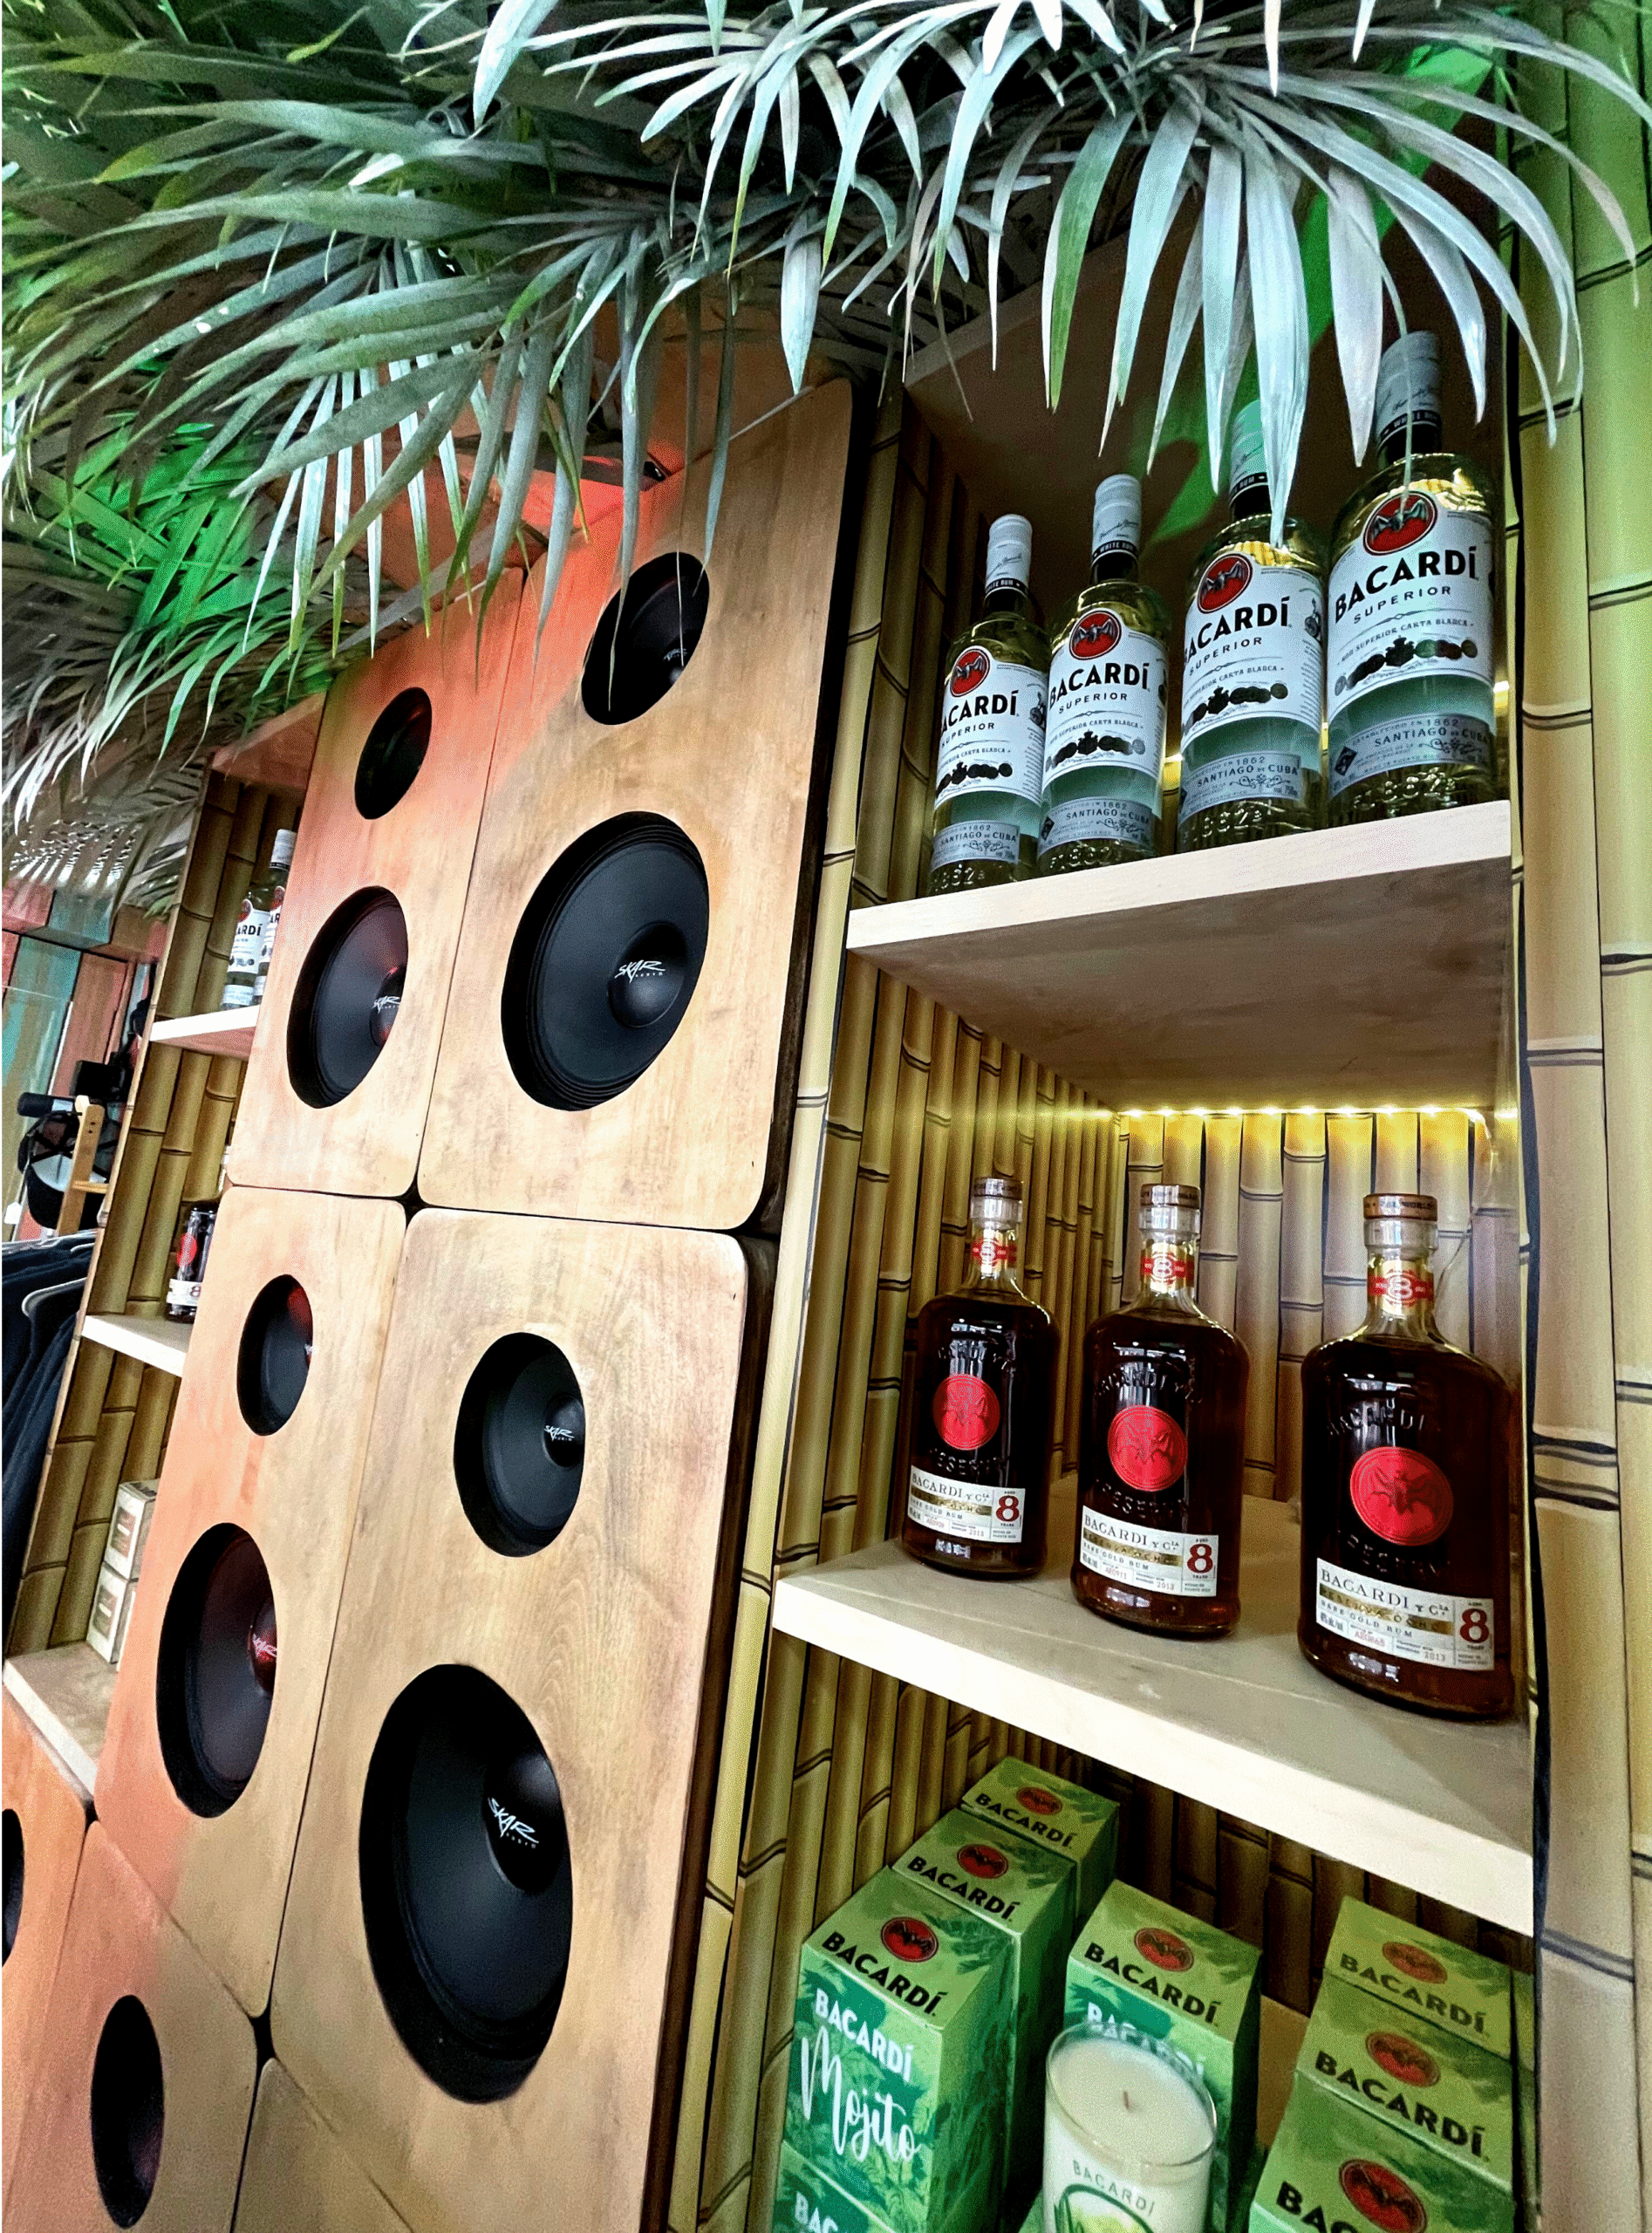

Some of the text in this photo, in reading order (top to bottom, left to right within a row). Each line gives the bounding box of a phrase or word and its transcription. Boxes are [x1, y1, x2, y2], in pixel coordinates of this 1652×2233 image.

[1335, 545, 1479, 624] BACARDÍ
[1354, 585, 1452, 625] SUPERIOR
[1184, 596, 1291, 666] ACARDÍ
[1355, 627, 1397, 652] SUPERIOR
[1400, 619, 1432, 632] CARTA
[1188, 637, 1263, 677] SUPERIOR
[1048, 662, 1150, 711] BACARDÍ
[1058, 692, 1129, 714] SUPERIOR
[942, 689, 1020, 733] ACARDÍ
[941, 722, 995, 749] SUPERIOR
[1374, 727, 1447, 748] SANTIAGO
[1197, 764, 1254, 787] SANTIAGO
[1267, 764, 1299, 776] CUBA
[1066, 808, 1118, 821] SANTIAGO
[941, 830, 982, 845] SANTIAGO
[992, 831, 1017, 843] CUBA
[911, 1472, 963, 1499] BACARDI
[924, 1505, 943, 1515] GOLD
[995, 1495, 1020, 1523] 8
[1084, 1514, 1148, 1547] BACARDI
[1102, 1551, 1124, 1564] GOLD
[1129, 1560, 1149, 1570] RUM
[1186, 1543, 1214, 1574] 8
[1321, 1568, 1409, 1609] BACARDI
[1349, 1612, 1380, 1629] GOLD
[1386, 1624, 1413, 1638] RUM
[1459, 1608, 1490, 1643] 8
[975, 1793, 1077, 1847] BACARDÍ
[907, 1856, 1021, 1922] BACARDÍ
[822, 1931, 948, 2017] BACARDÍ
[1084, 1942, 1222, 2025] BACARDÍ
[1340, 1953, 1487, 2033] BACARDÍ
[814, 1987, 915, 2083] BACARDÍ
[801, 2025, 923, 2163] Mojito
[1314, 2050, 1485, 2159] BACARDÍ
